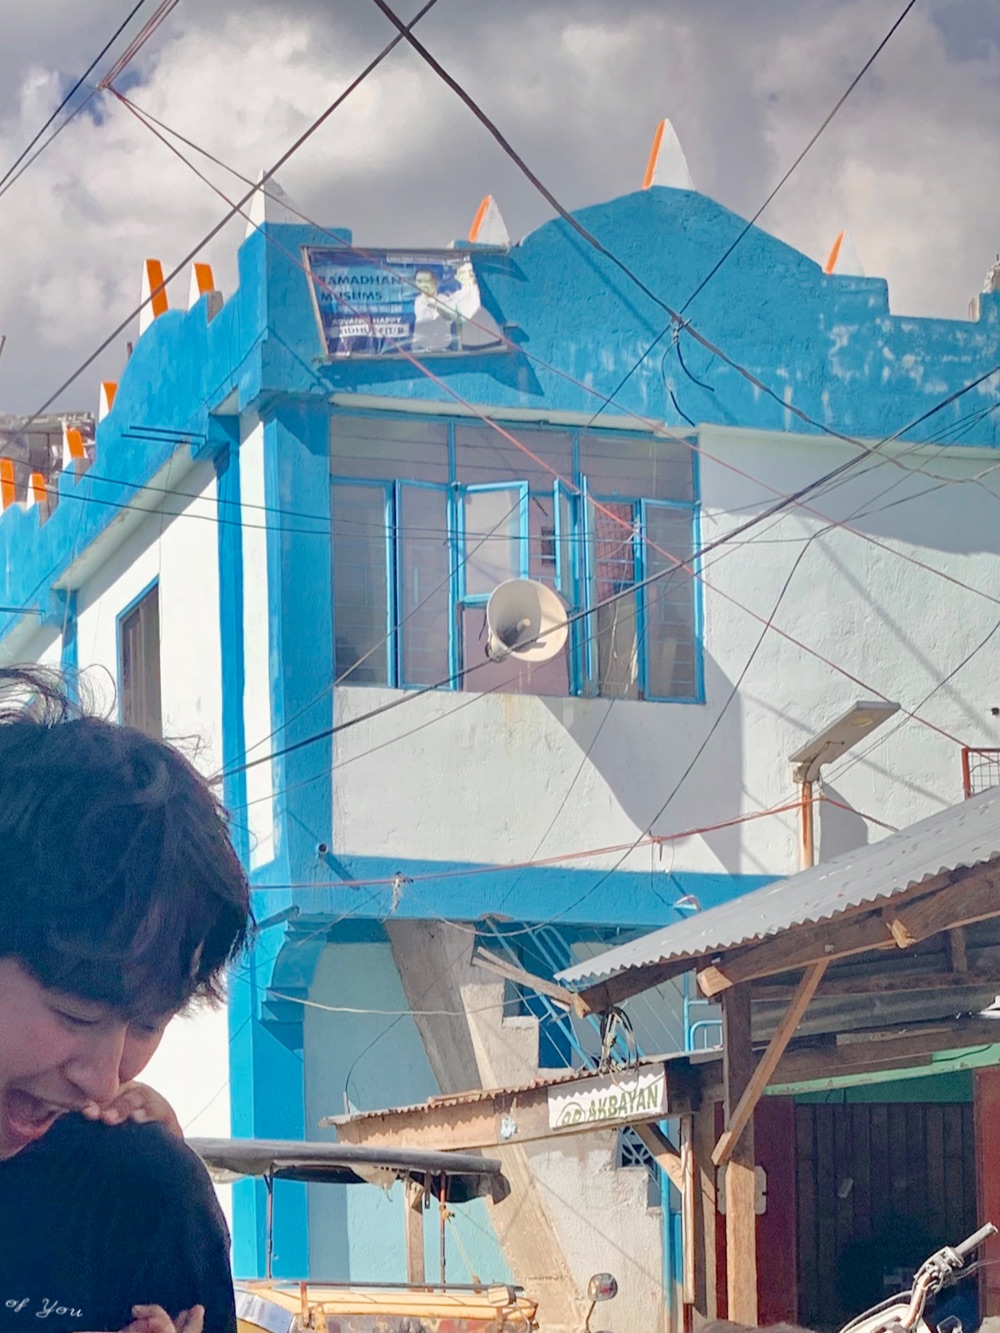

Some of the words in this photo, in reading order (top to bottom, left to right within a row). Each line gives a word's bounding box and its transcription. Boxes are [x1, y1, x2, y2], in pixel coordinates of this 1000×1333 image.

[587, 1084, 659, 1121] AKBAYAN
[5, 1297, 30, 1313] of
[35, 1298, 84, 1318] You
